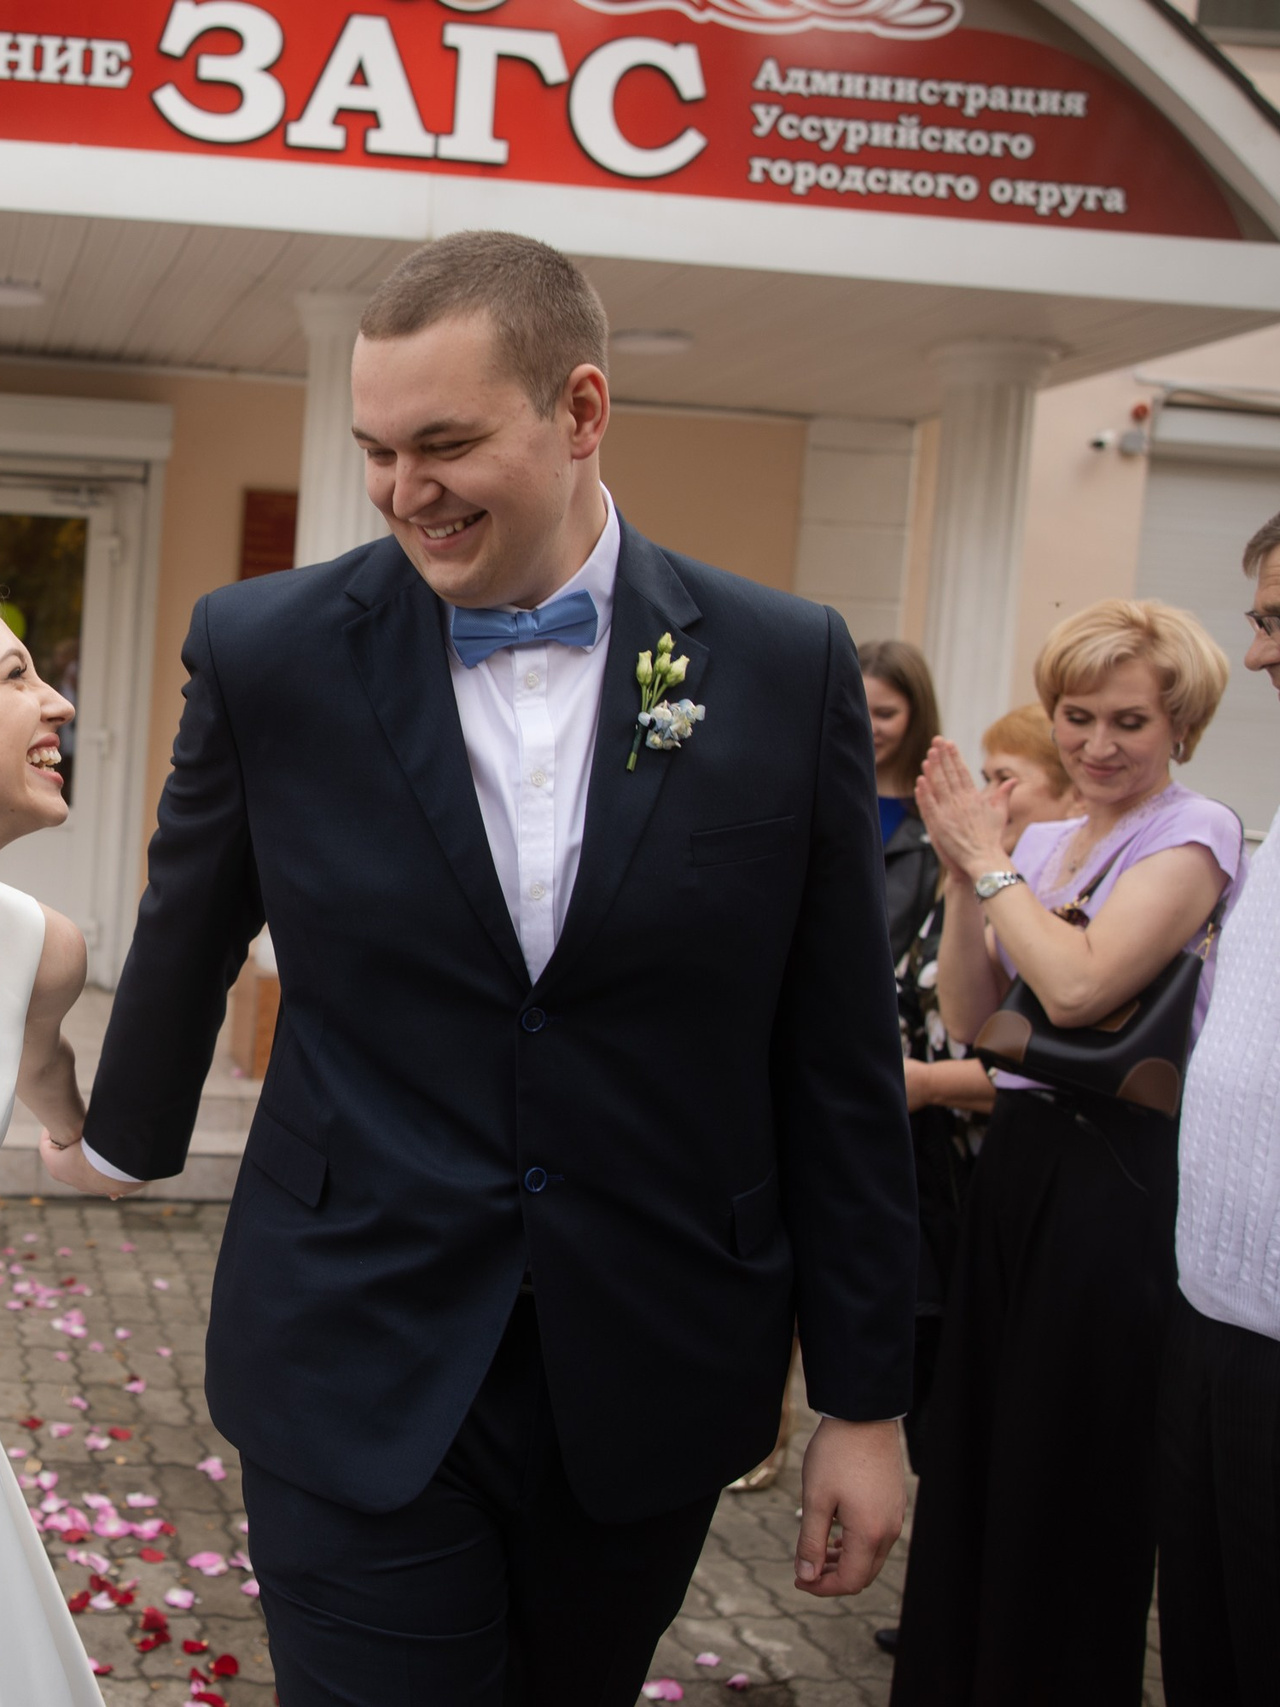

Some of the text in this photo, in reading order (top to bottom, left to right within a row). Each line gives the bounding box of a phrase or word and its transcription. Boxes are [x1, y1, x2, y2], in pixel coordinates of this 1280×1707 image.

[152, 0, 706, 178] ЗАГС
[754, 59, 1087, 117] Администрация
[753, 105, 1034, 159] Уссурийского
[749, 158, 1126, 217] городского округа
